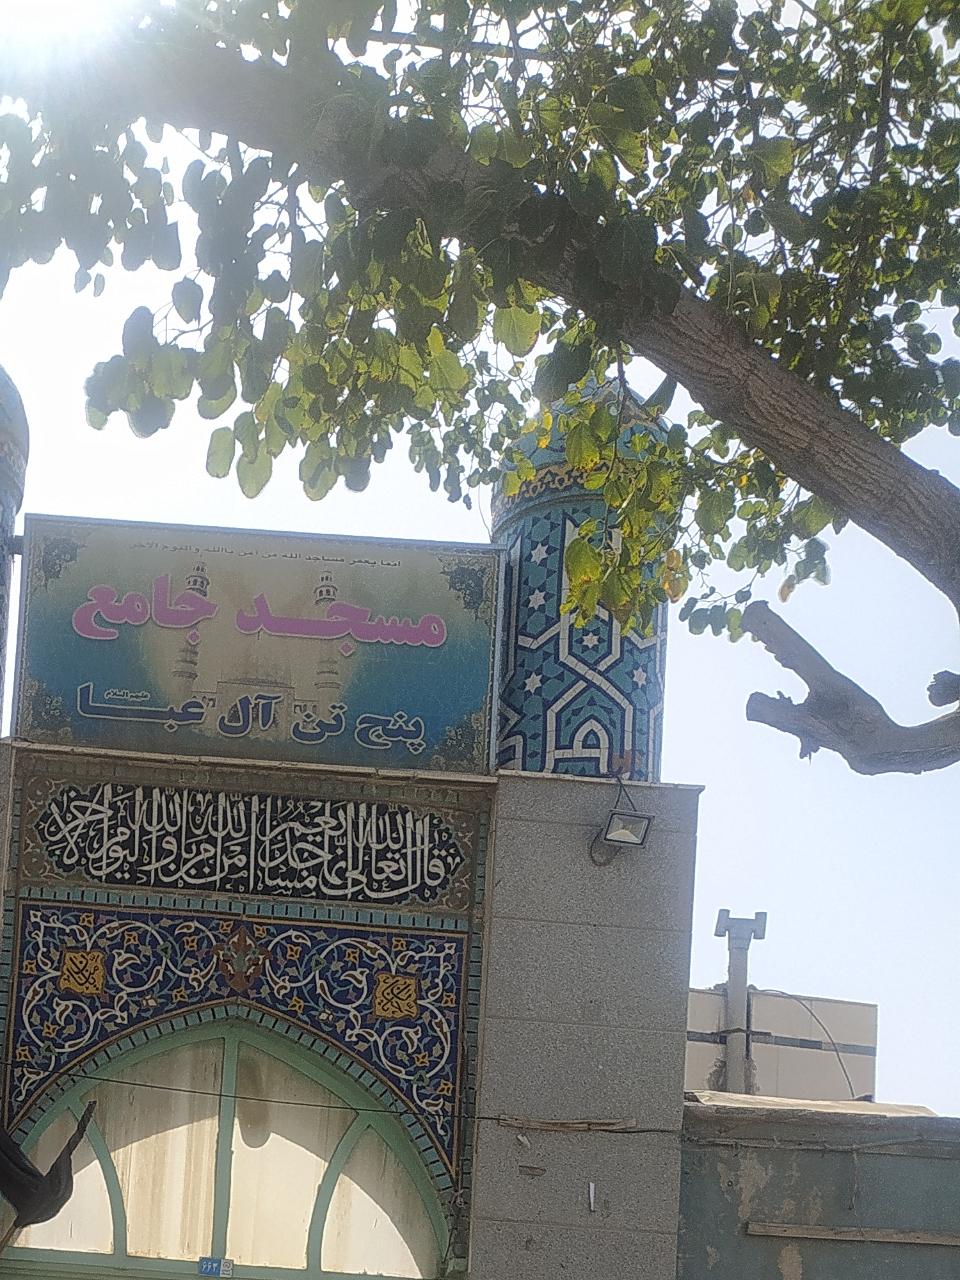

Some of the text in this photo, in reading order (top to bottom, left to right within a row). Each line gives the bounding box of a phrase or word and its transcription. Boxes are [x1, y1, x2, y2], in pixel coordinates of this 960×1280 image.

[72, 574, 447, 656] مسجد جامع
[77, 682, 426, 754] پنج تن آل عبا
